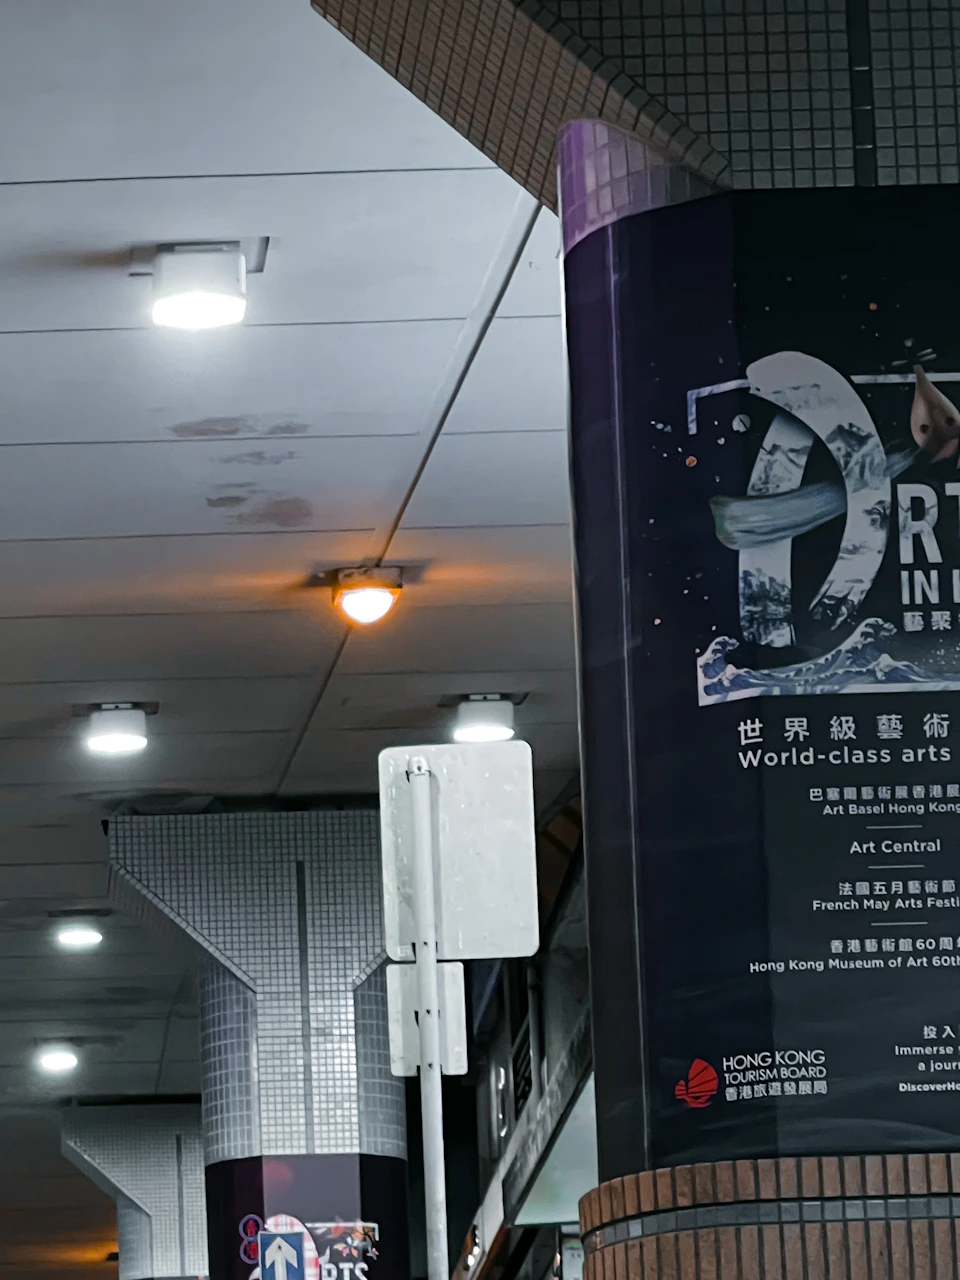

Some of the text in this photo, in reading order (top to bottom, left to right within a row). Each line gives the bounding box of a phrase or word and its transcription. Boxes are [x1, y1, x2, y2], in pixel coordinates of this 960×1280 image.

[900, 569, 940, 605] IN
[737, 713, 951, 746] 世界級藝術
[738, 744, 952, 769] World-class arts
[823, 804, 845, 816] Art
[848, 803, 885, 815] Basel
[889, 803, 925, 815] Hong
[850, 839, 941, 854] Art Central
[812, 899, 859, 911] French
[864, 899, 890, 911] May
[895, 898, 923, 909] Arts
[749, 961, 785, 973] Hong
[790, 959, 825, 972] Kong
[828, 957, 884, 970] Museum
[888, 956, 903, 968] of
[906, 956, 928, 967] Art
[895, 1045, 954, 1055] Immerse
[722, 1050, 826, 1072] HONG KONG
[724, 1066, 827, 1085] TOURISM BOARD
